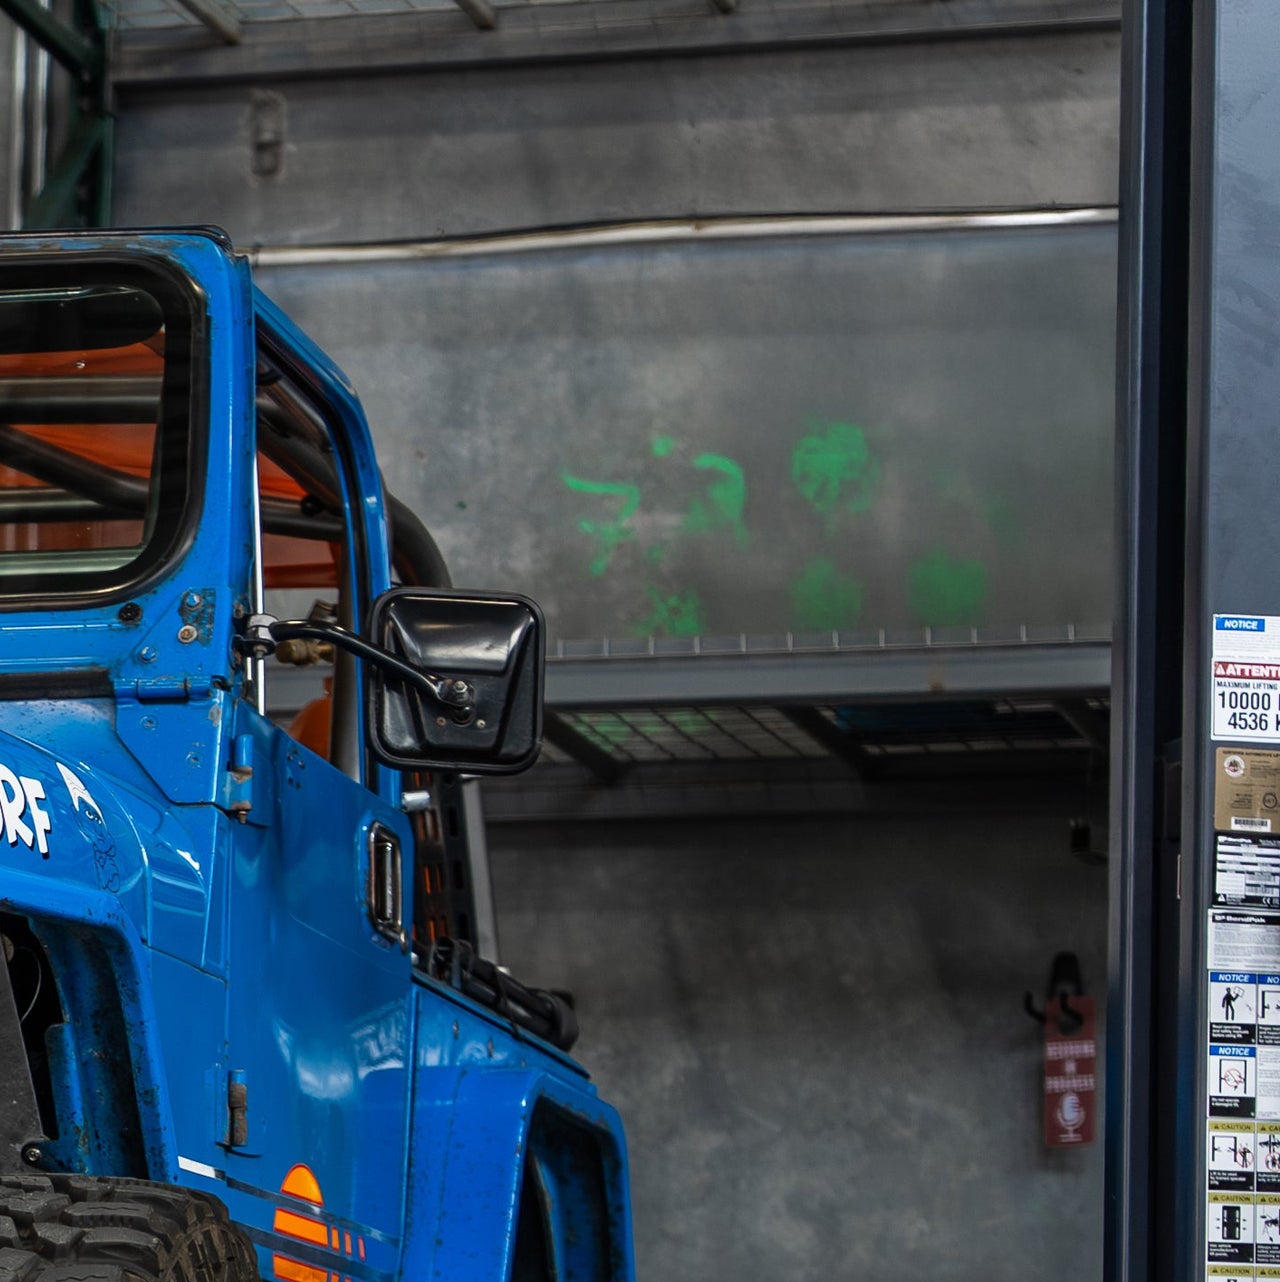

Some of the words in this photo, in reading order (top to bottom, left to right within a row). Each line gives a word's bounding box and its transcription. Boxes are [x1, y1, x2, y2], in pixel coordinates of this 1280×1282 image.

[1223, 619, 1259, 630] NOTICE
[1226, 663, 1280, 678] ATTENT
[1216, 680, 1251, 689] MAXIMUM
[1253, 682, 1278, 690] LIFTING
[1218, 690, 1271, 711] 10000
[1228, 712, 1268, 731] 4536
[1218, 973, 1250, 983] NOTICE
[1218, 1047, 1250, 1056] NOTICE
[1221, 1123, 1251, 1131] CAUTION
[1220, 1194, 1251, 1202] CAUTION
[1220, 1267, 1250, 1275] CAUTION
